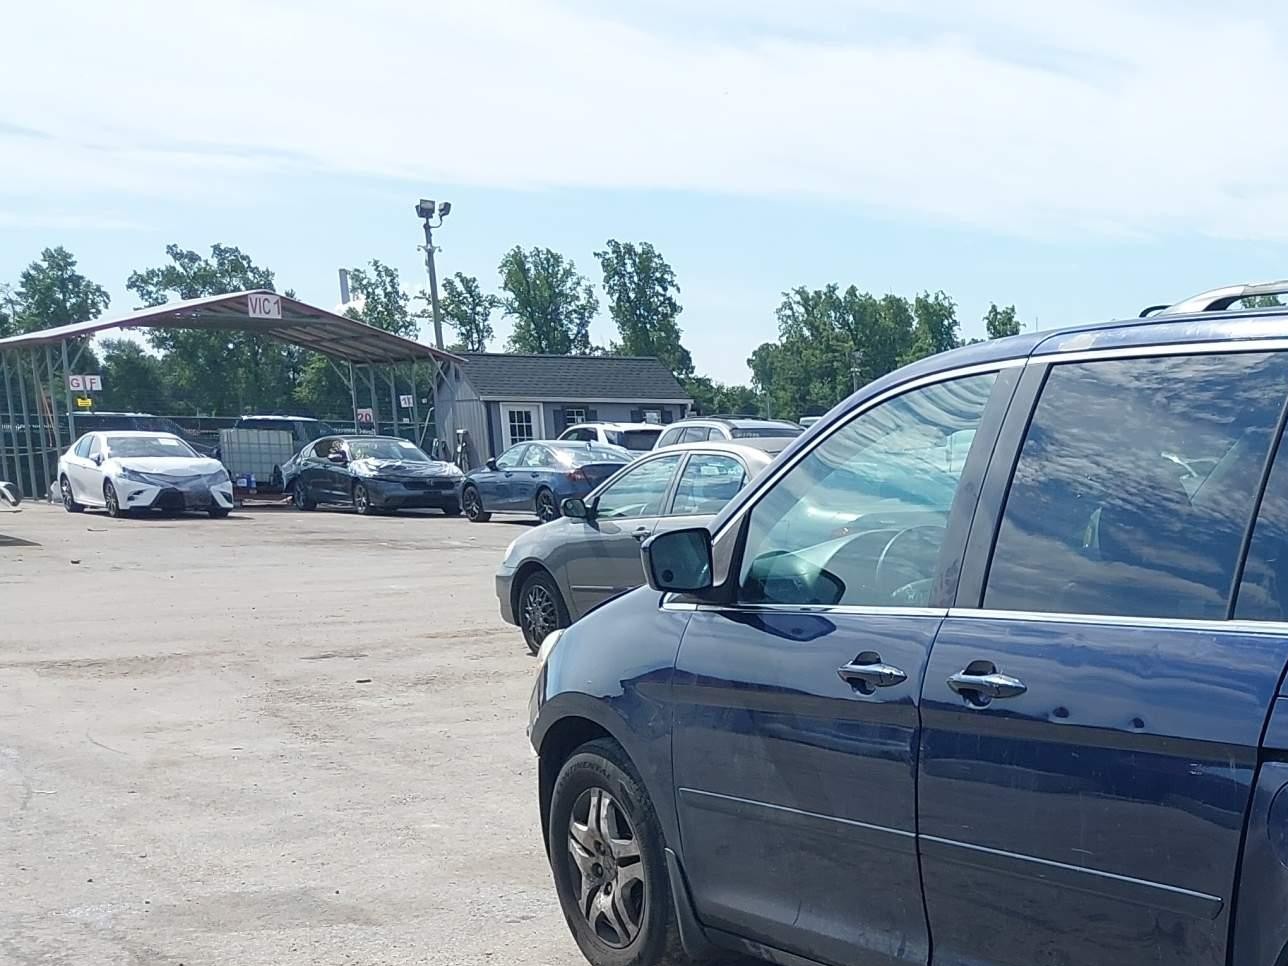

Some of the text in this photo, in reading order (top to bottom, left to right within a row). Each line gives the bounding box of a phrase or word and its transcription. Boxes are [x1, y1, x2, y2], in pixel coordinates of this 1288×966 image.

[249, 297, 281, 316] VIC 1
[71, 378, 80, 388] G
[90, 378, 97, 390] F
[358, 413, 372, 423] 20
